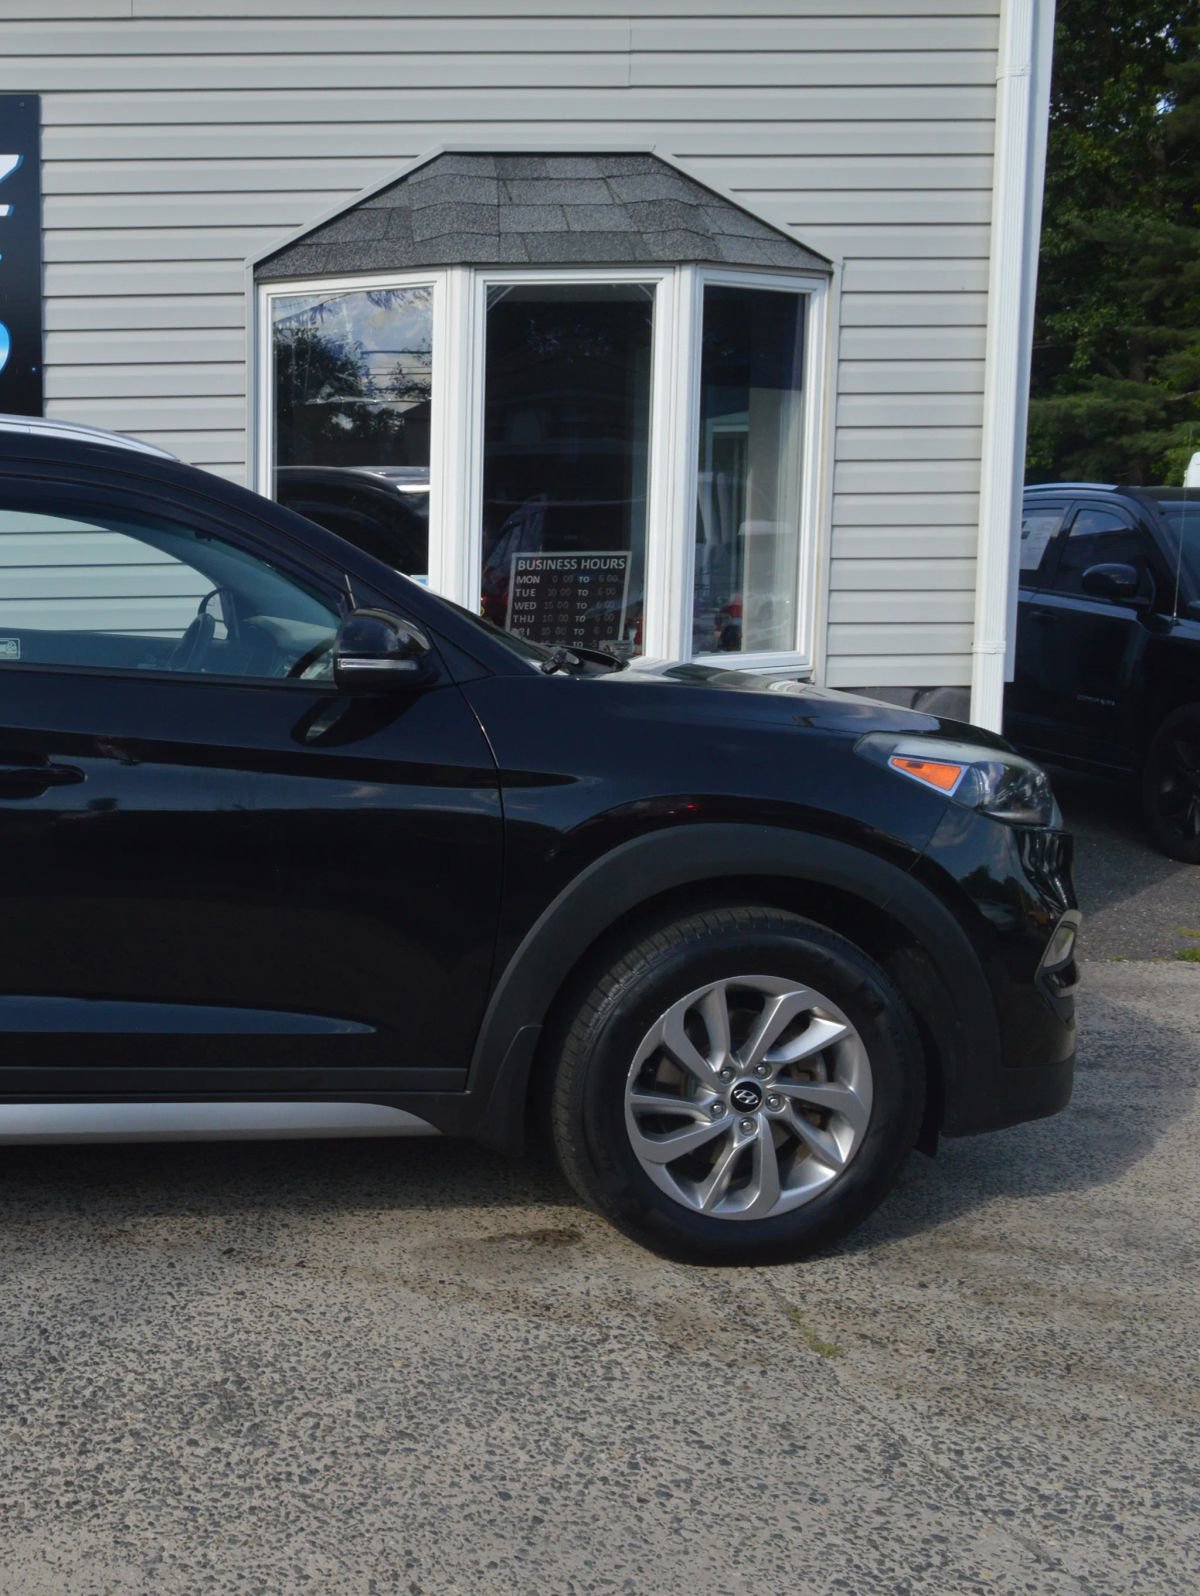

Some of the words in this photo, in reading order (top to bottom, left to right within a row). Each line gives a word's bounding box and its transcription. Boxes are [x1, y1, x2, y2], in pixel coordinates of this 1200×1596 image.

[517, 559, 577, 571] BUSINESS
[580, 558, 626, 569] HOURS
[516, 575, 540, 584] MON
[578, 575, 590, 583] TO
[515, 588, 536, 597] TUE
[577, 589, 589, 597] TO
[514, 601, 537, 610] WED
[512, 614, 535, 623] THU
[575, 615, 586, 623] TO
[573, 628, 584, 636] TO
[572, 641, 584, 649] TO
